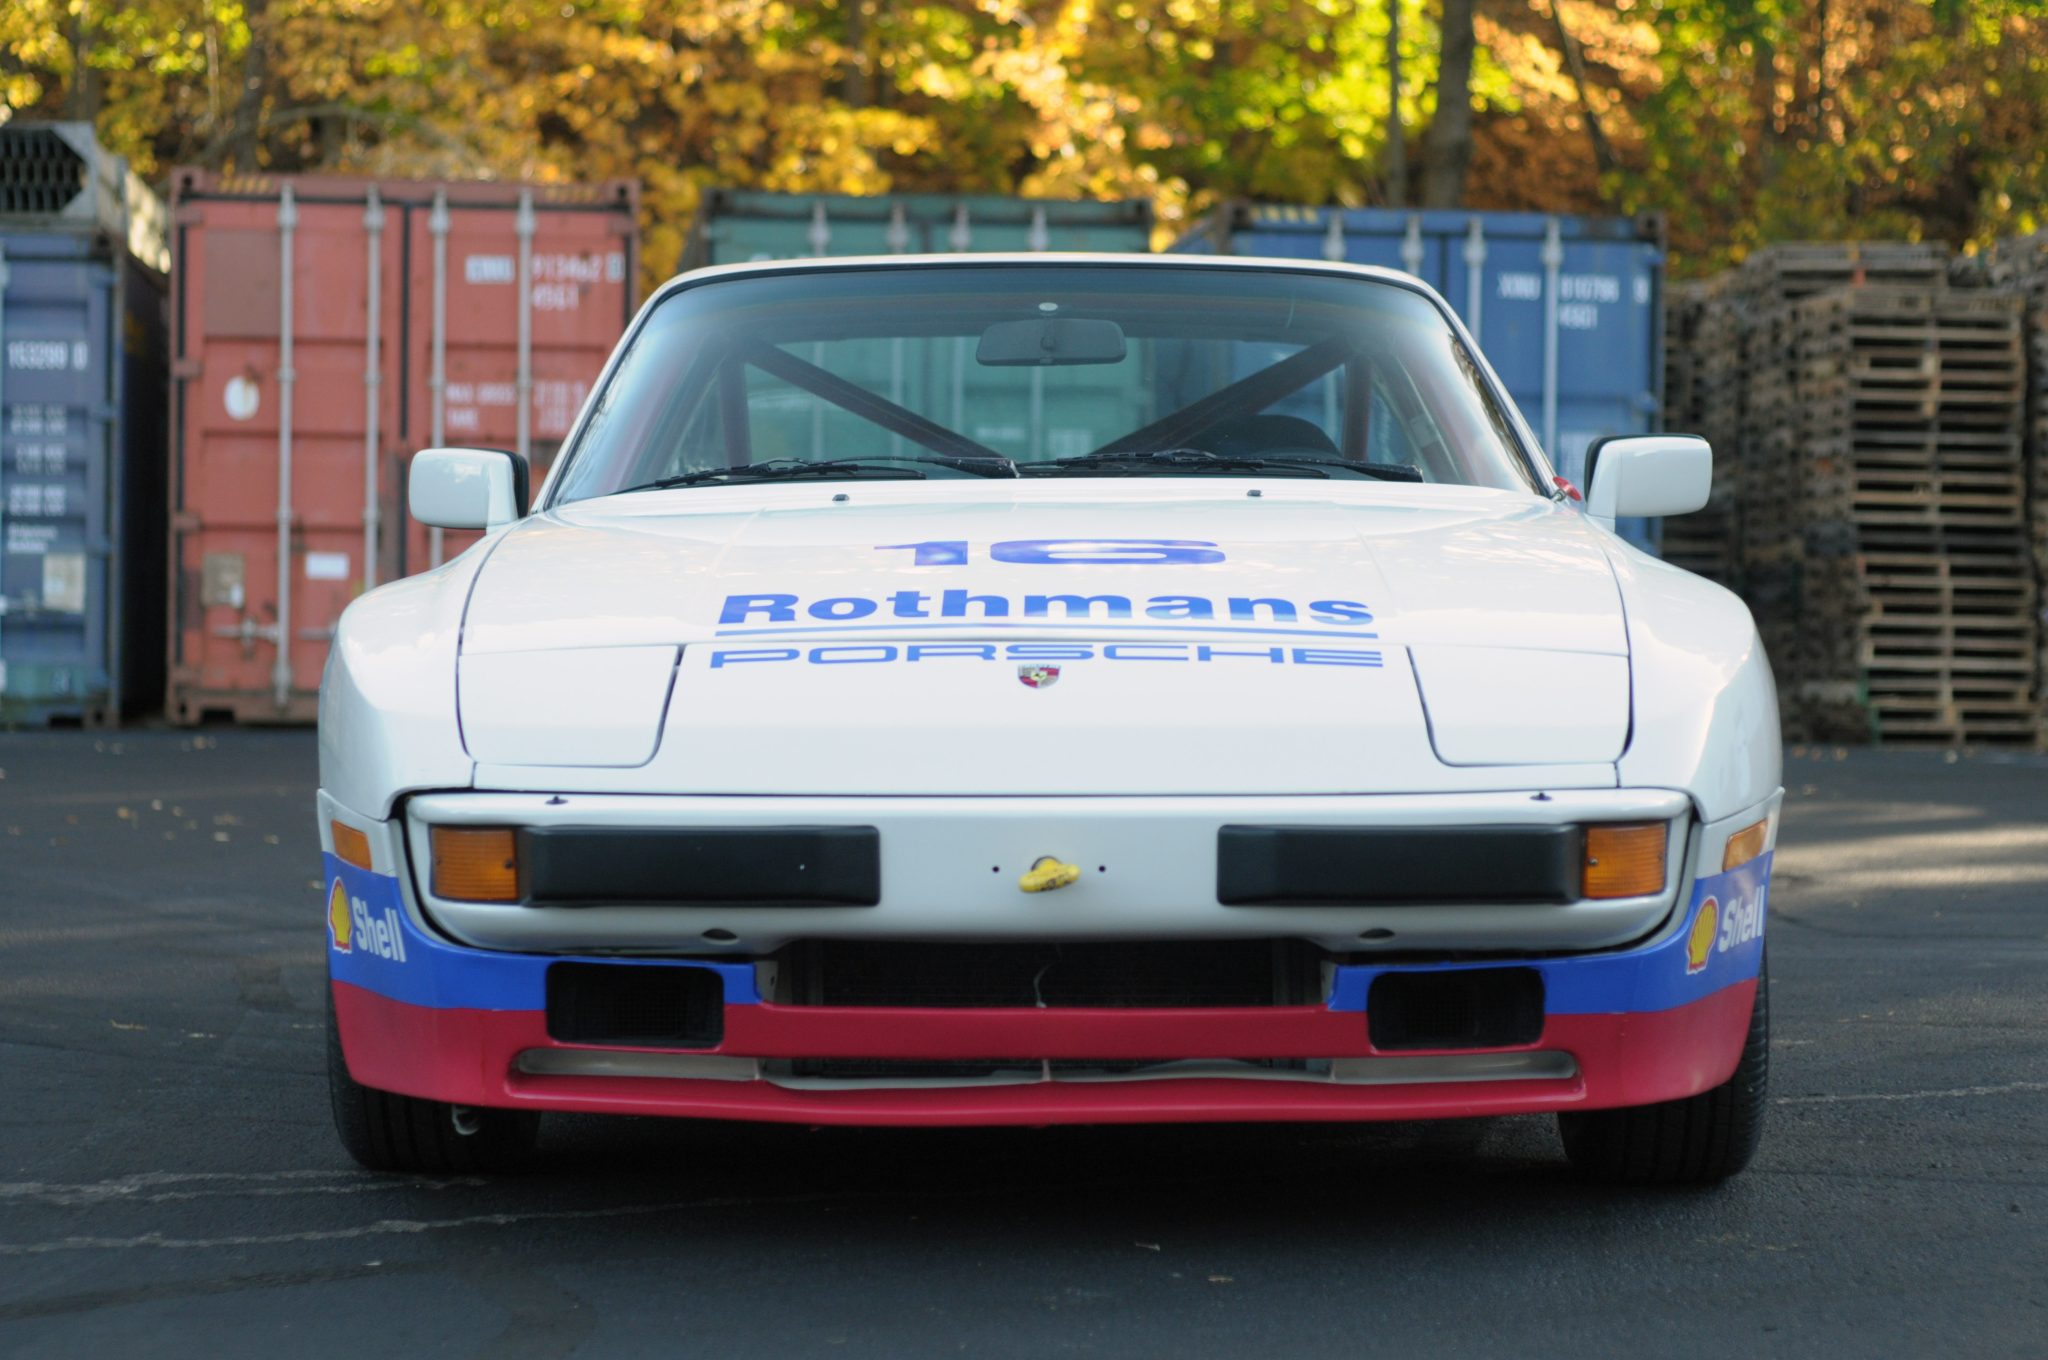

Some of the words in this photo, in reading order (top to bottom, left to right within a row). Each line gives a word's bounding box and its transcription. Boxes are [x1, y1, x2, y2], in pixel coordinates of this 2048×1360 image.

[873, 539, 1226, 566] 16
[718, 589, 1374, 625] Rothmans
[710, 644, 1383, 668] PORSCHE
[351, 896, 407, 963] Shell
[1717, 885, 1765, 953] Shell
